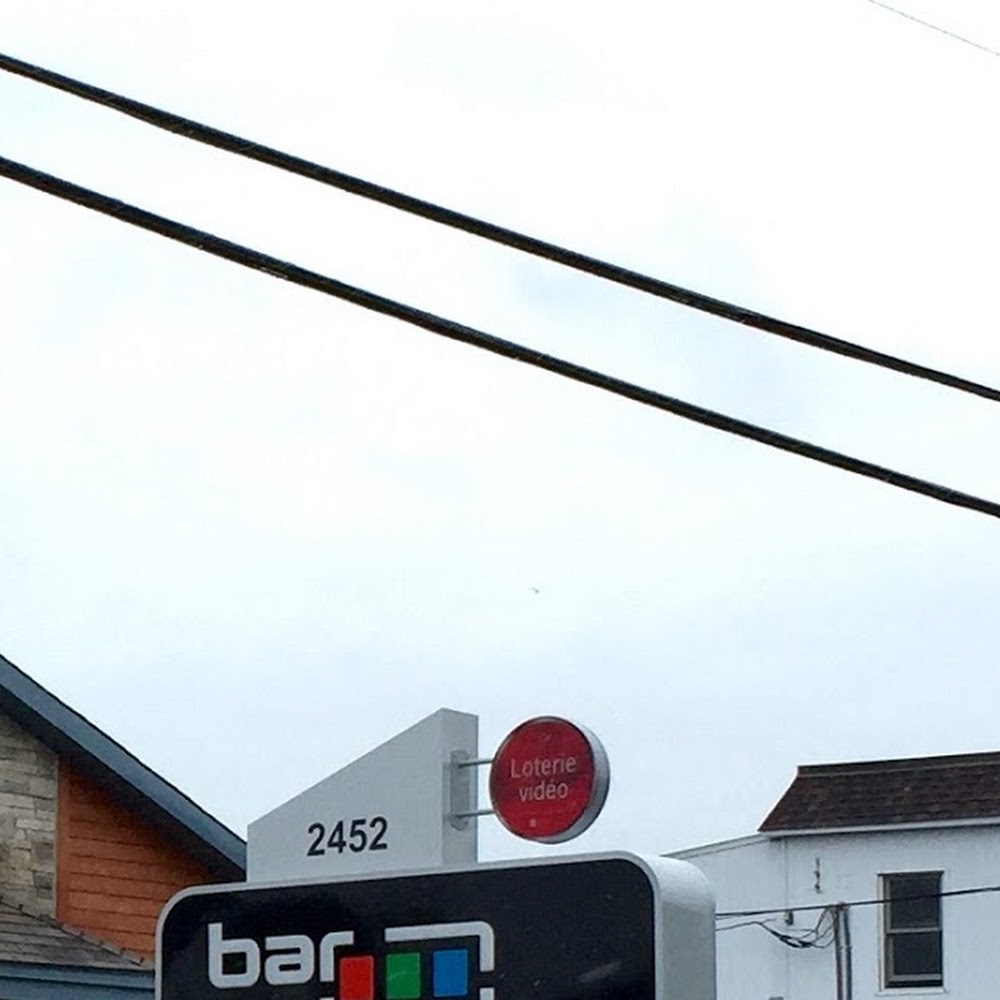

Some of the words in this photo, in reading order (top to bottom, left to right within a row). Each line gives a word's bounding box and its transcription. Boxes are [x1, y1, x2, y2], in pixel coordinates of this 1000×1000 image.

[510, 757, 577, 779] Loterie
[518, 779, 569, 802] vidéo
[307, 816, 388, 857] 2452
[208, 922, 354, 989] bar
